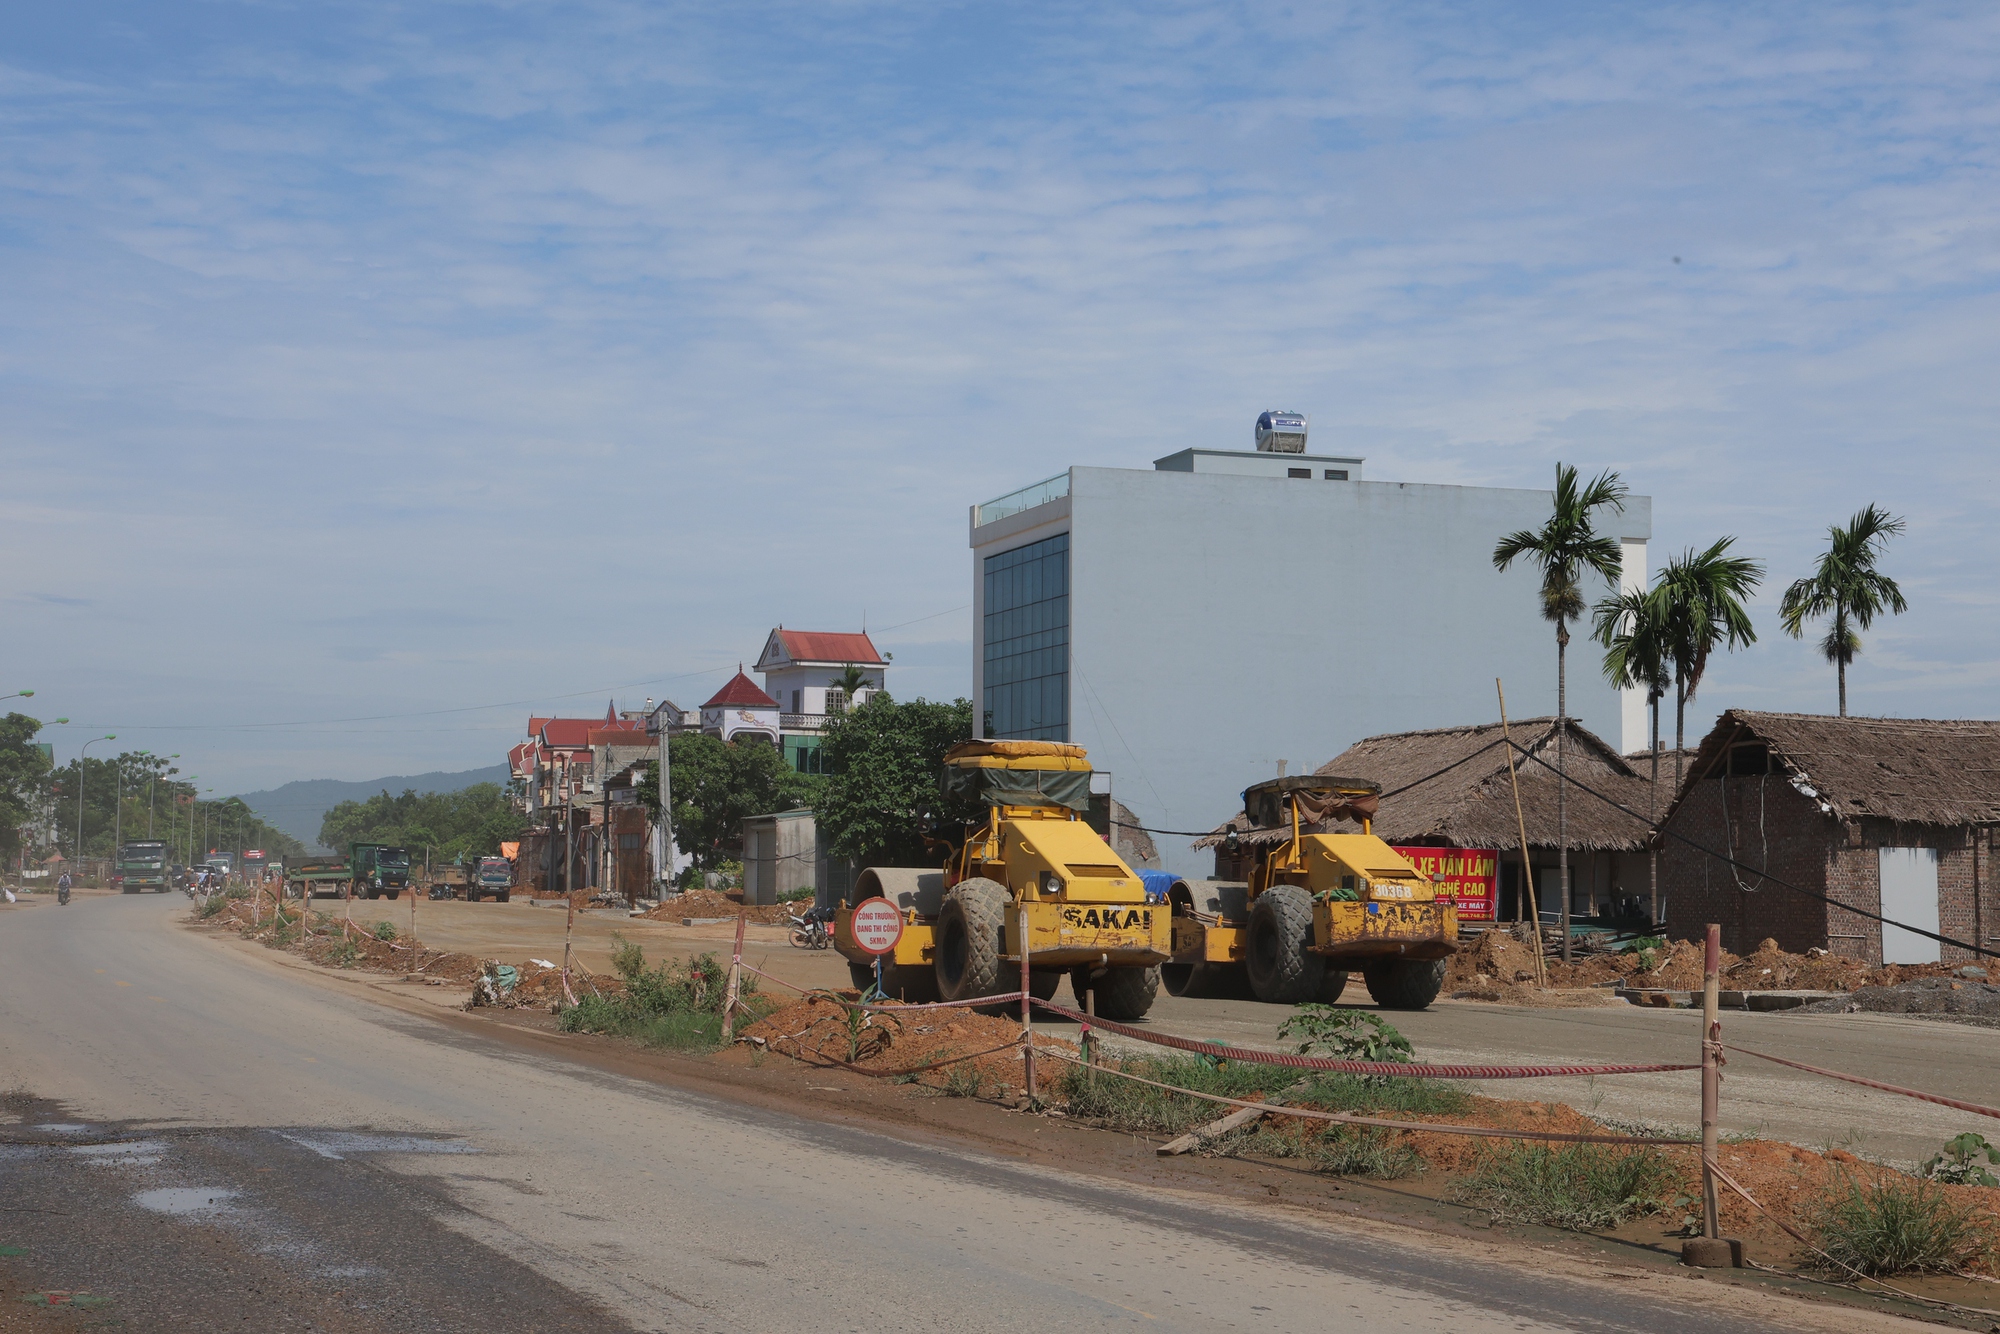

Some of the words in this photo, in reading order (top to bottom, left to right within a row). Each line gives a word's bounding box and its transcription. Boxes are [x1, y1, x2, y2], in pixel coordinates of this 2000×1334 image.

[1420, 857, 1435, 875] XE
[1439, 854, 1464, 876] VĂN
[1467, 855, 1494, 877] LÂM
[1374, 884, 1412, 898] 30368
[1463, 882, 1486, 896] CAO
[858, 911, 873, 920] CÔNG
[874, 910, 896, 920] TRƯỜNG
[1063, 908, 1150, 930] SAKAI
[883, 923, 898, 932] CÔNG
